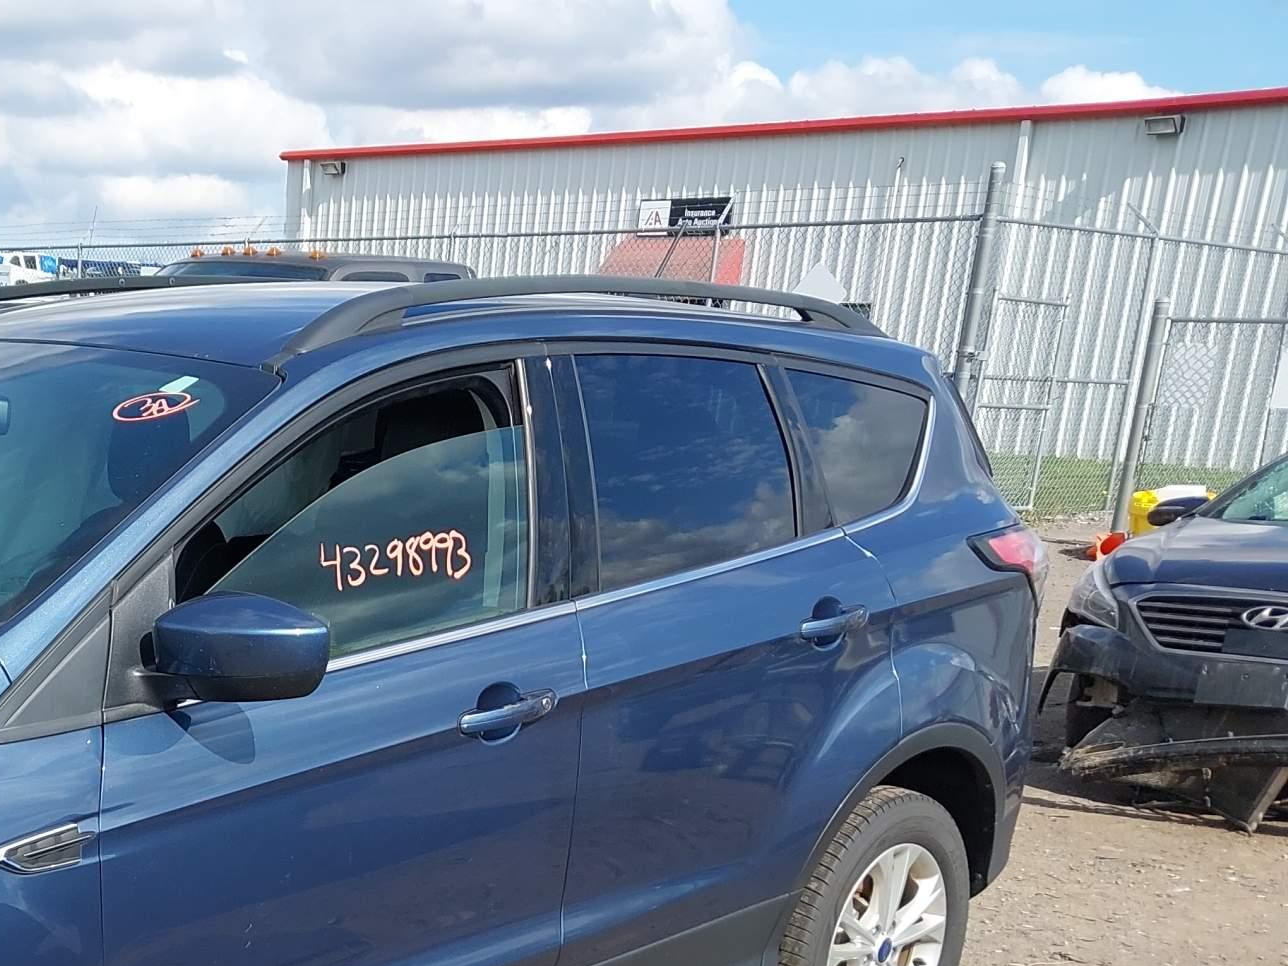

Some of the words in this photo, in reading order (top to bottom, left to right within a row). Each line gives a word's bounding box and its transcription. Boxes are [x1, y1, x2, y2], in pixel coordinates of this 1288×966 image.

[685, 208, 715, 217] Insurance
[693, 217, 720, 226] Auction
[320, 529, 472, 592] 43298993
